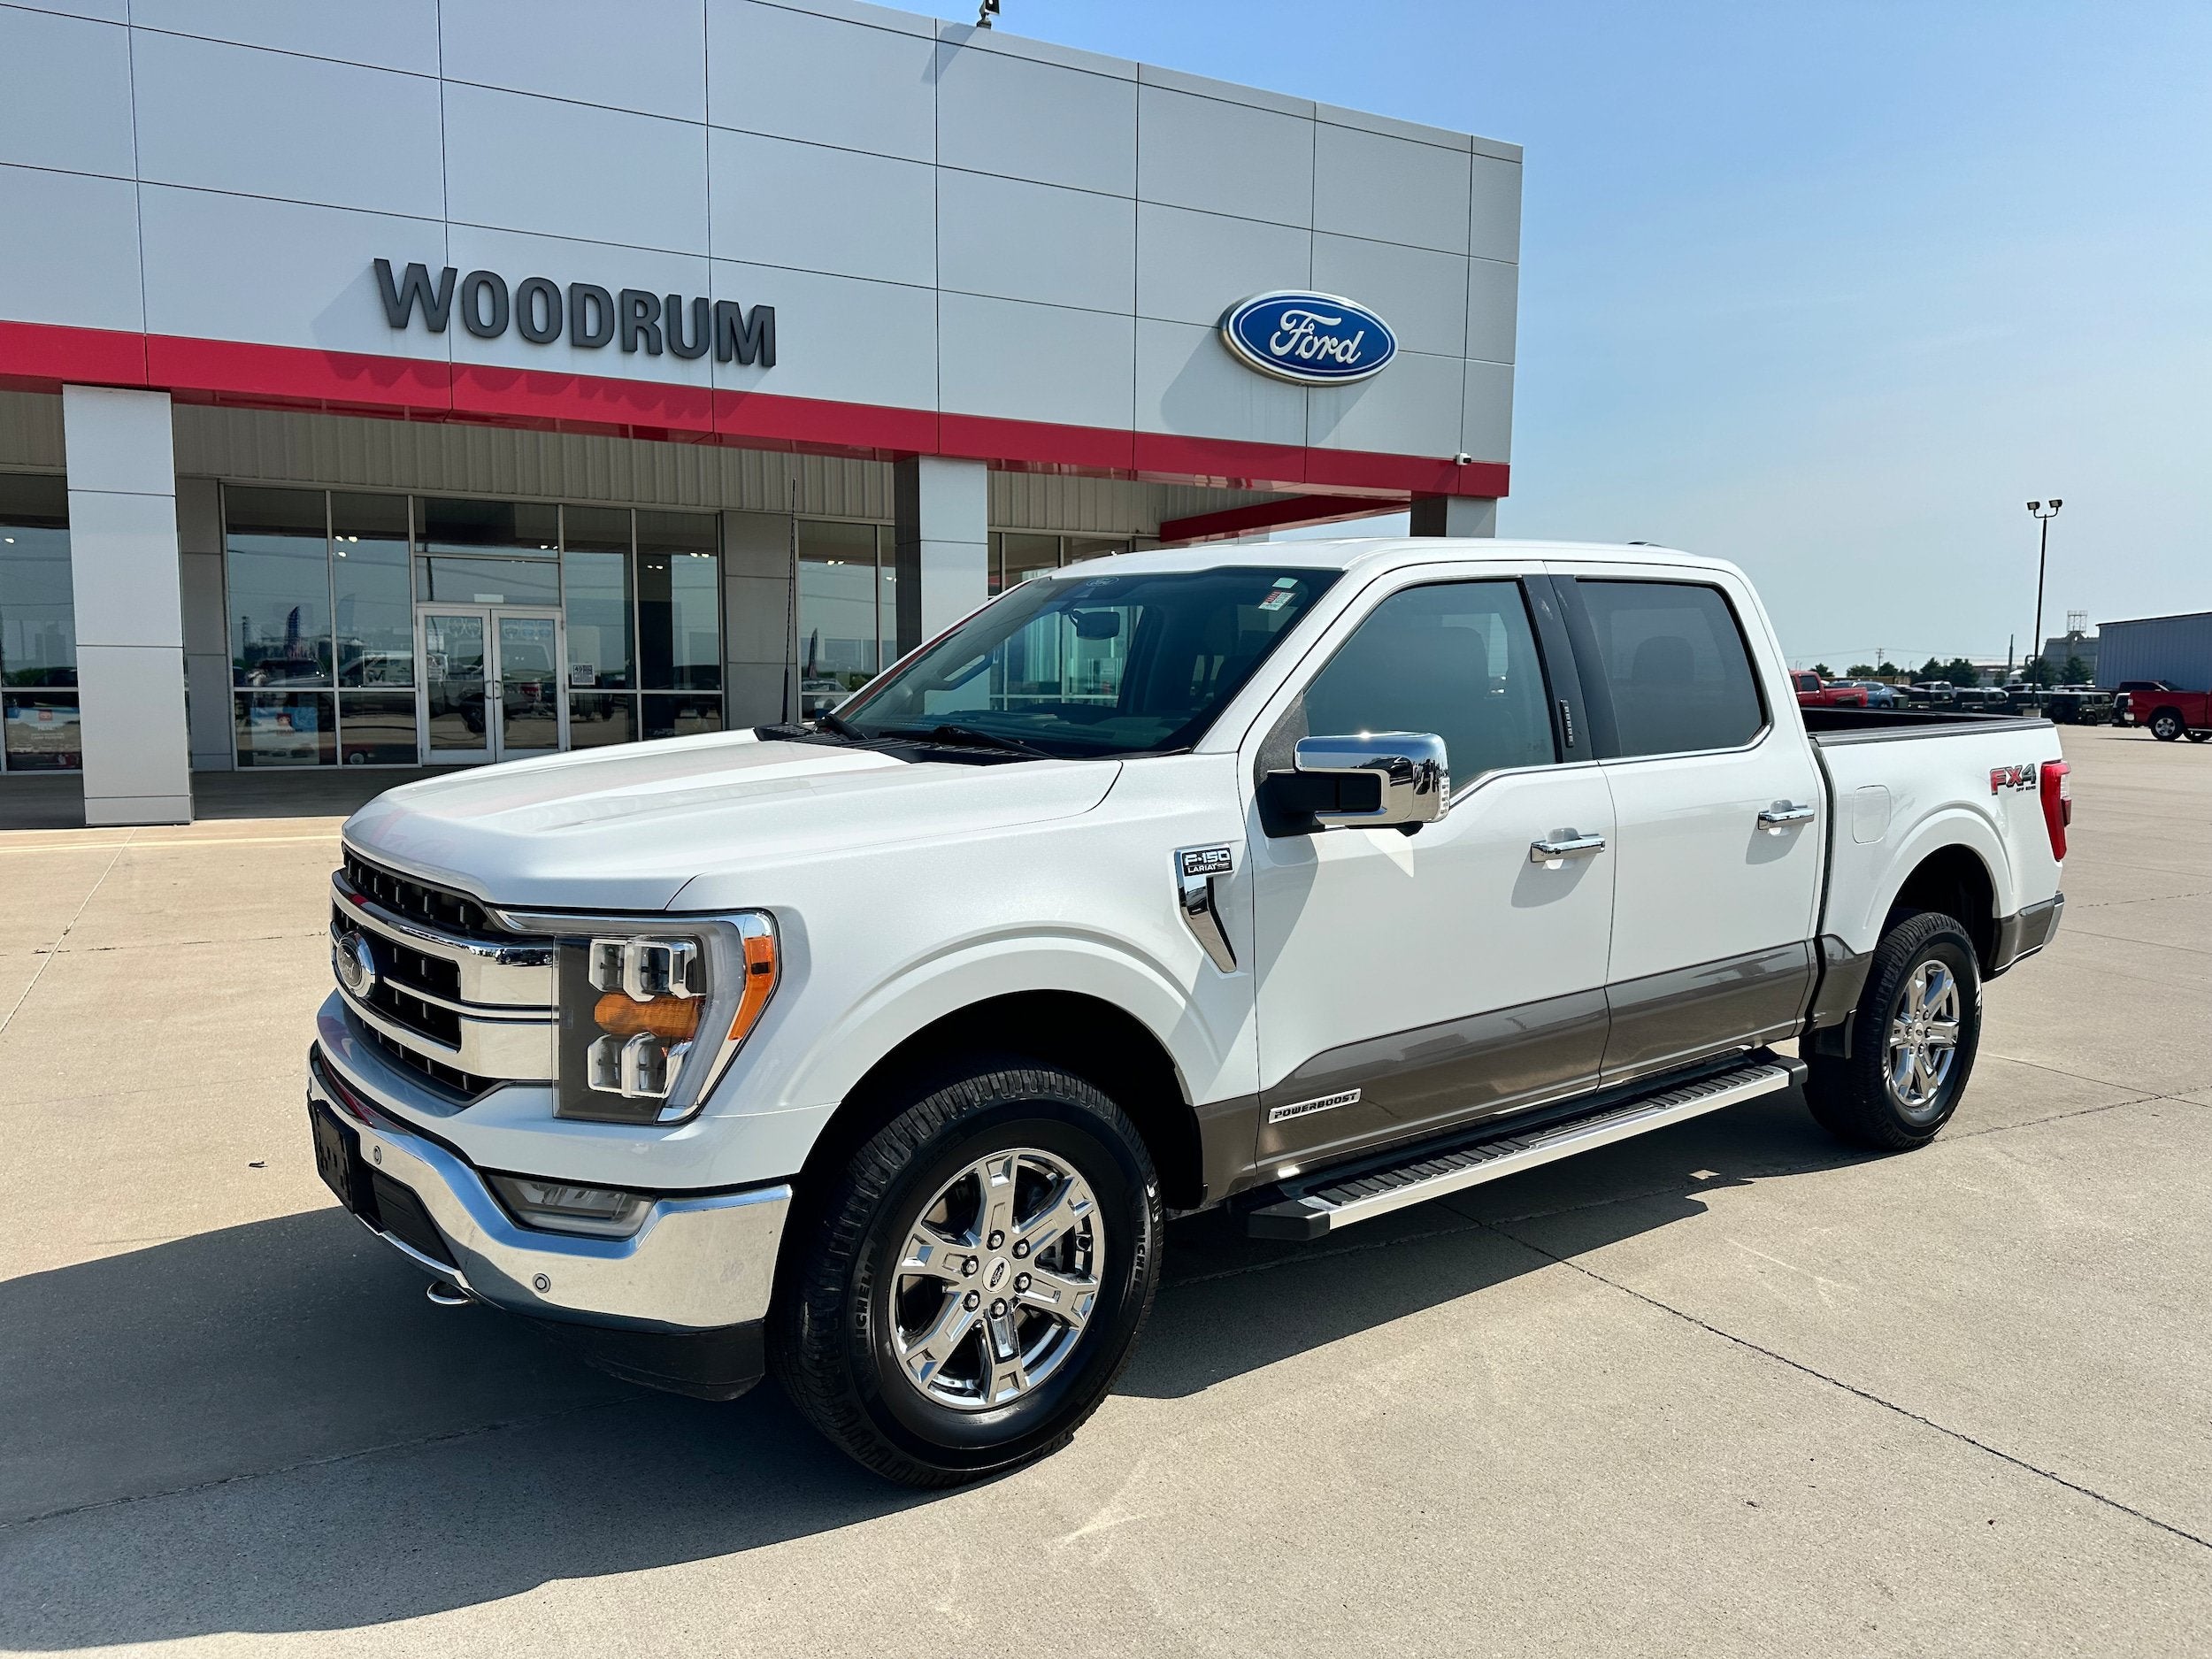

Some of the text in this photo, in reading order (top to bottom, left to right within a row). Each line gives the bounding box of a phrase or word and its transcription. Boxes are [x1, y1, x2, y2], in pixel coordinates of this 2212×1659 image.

[373, 257, 777, 367] WOODRUM
[1269, 309, 1365, 365] Ford
[1989, 763, 2037, 796] FX4
[1185, 849, 1231, 866] F-150
[1187, 863, 1217, 873] LARIAT
[1274, 1092, 1356, 1119] POWERBOOST
